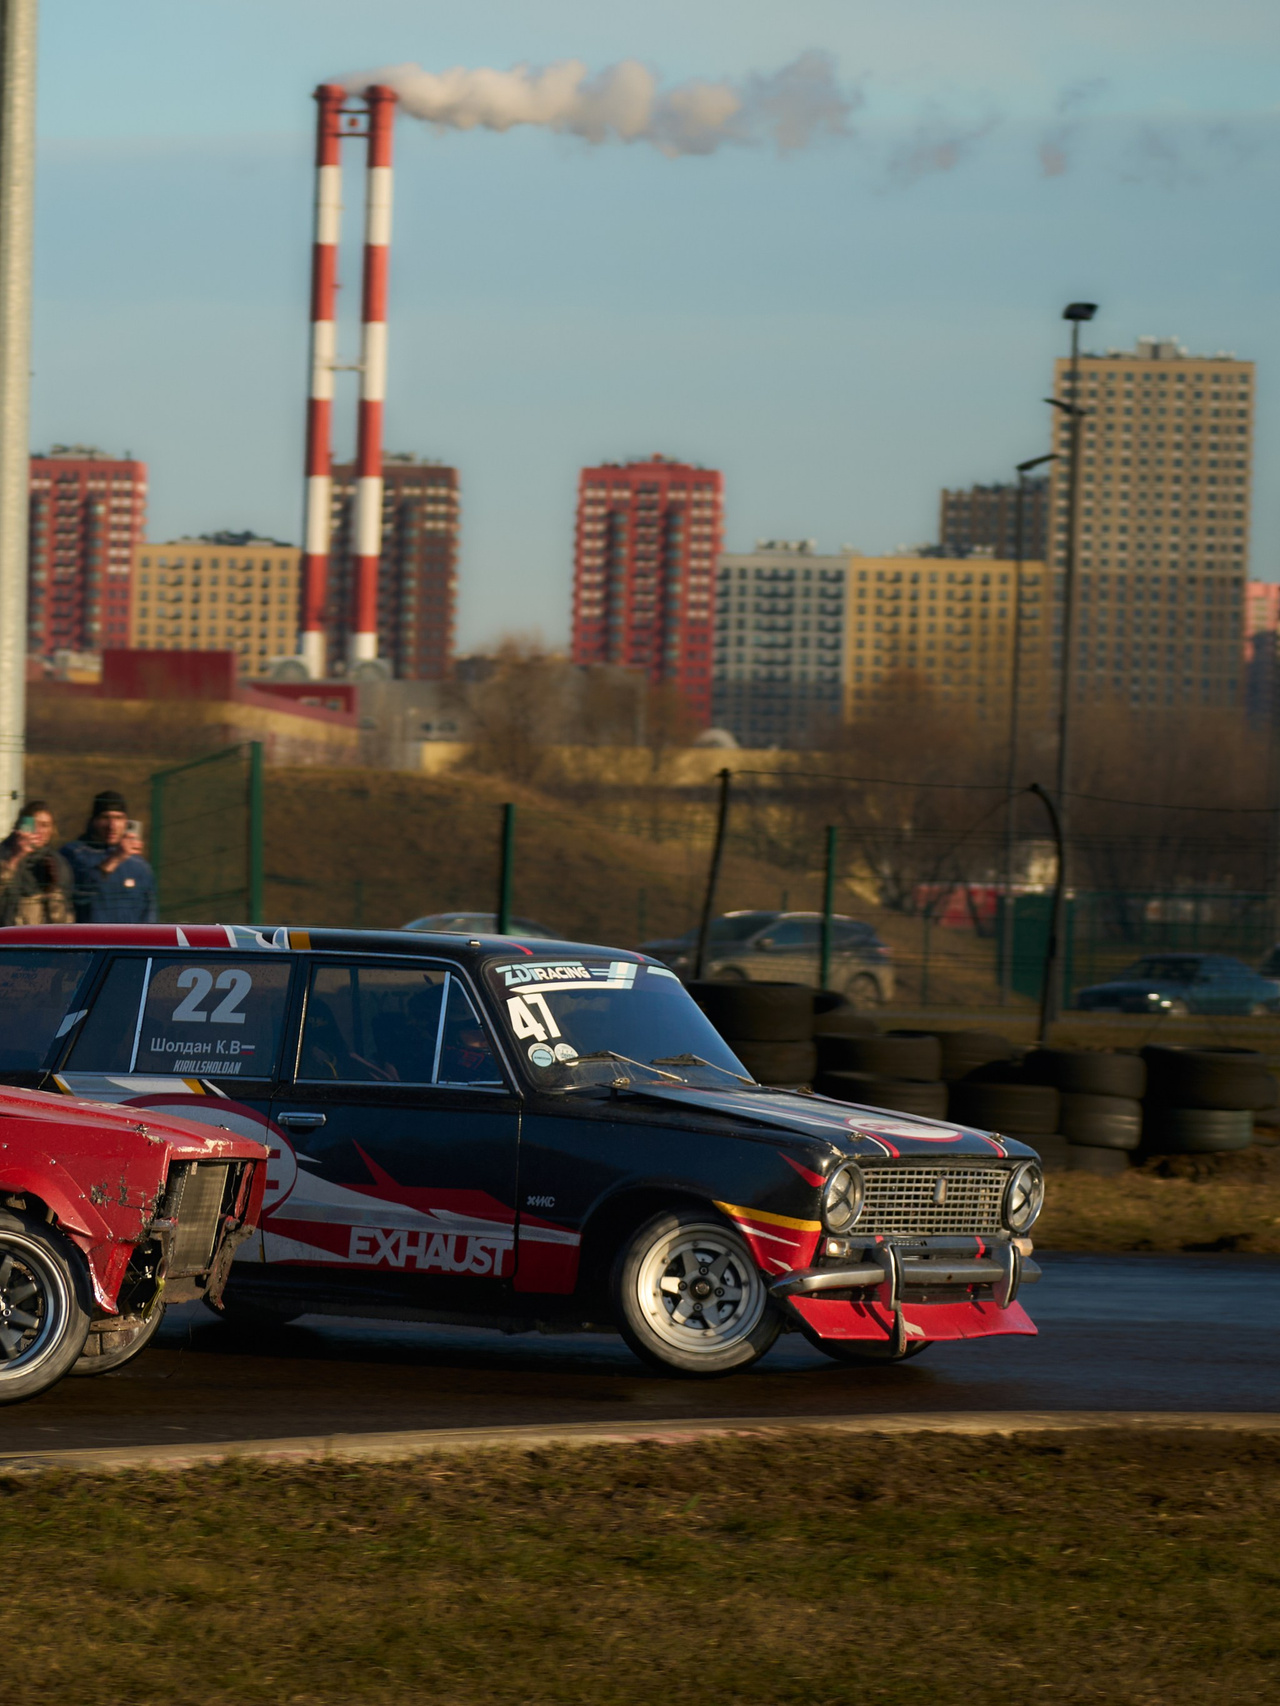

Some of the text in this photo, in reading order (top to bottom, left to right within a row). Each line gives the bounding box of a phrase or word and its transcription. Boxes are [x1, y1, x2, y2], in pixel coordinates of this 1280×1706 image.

[171, 967, 252, 1024] 22
[506, 993, 562, 1042] 47
[150, 1037, 211, 1055] Шолдан
[348, 1226, 515, 1276] EXHAUST
